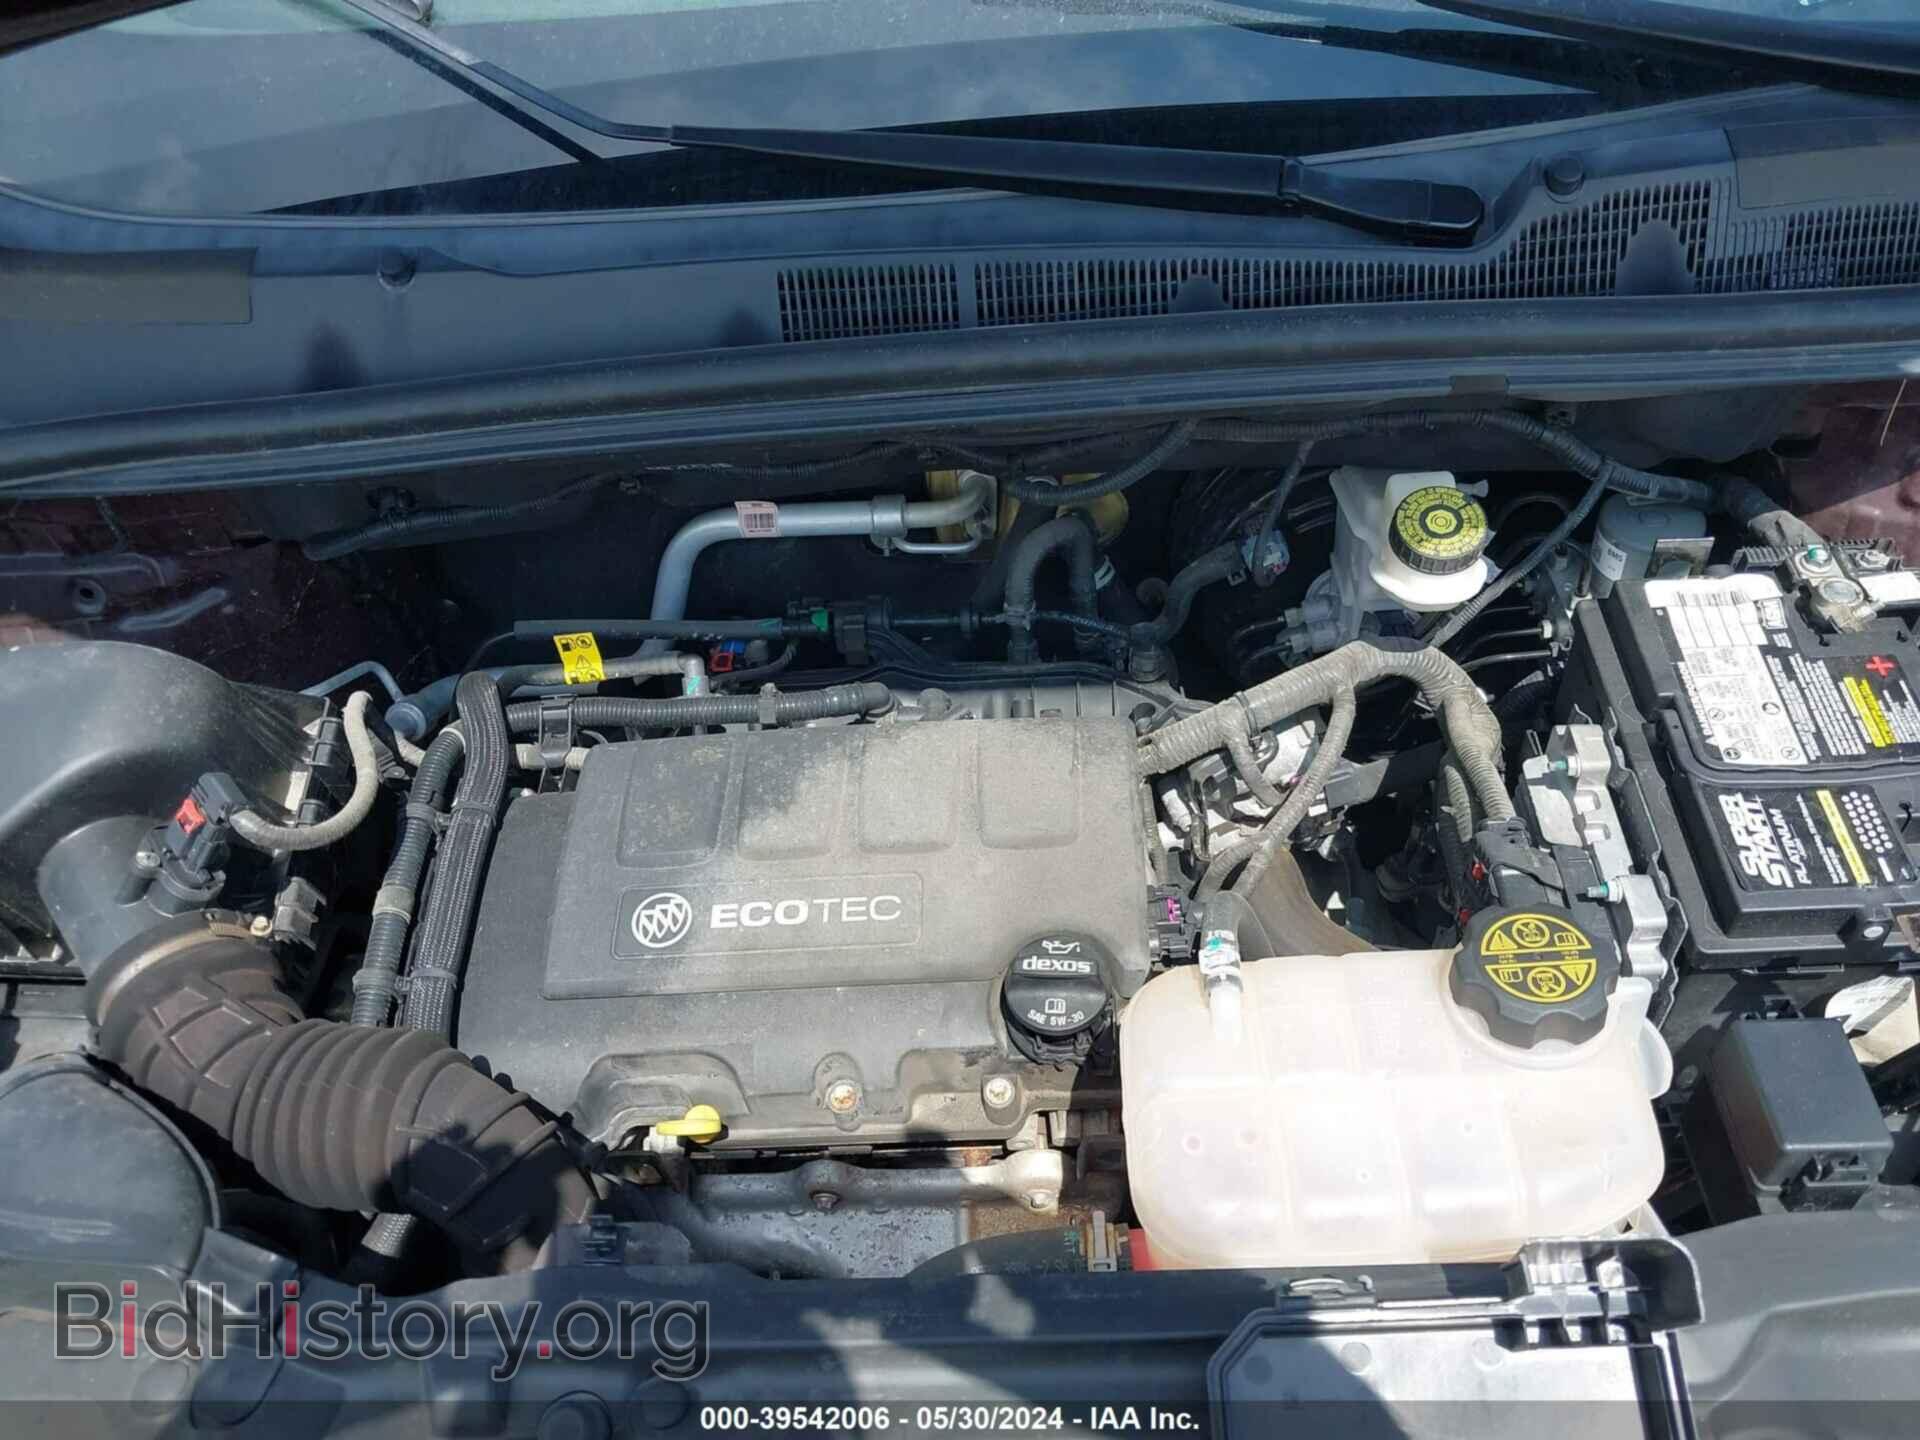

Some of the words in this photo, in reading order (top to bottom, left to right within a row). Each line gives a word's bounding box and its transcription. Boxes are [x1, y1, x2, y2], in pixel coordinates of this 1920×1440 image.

[1718, 792, 1760, 877] SUPER
[1744, 798, 1795, 888] START
[1768, 808, 1812, 885] PLATINUM
[709, 895, 902, 929] ECOTEC
[1022, 955, 1093, 973] dexos
[1027, 1008, 1047, 1025] SAE
[1050, 1010, 1085, 1027] 5W-30
